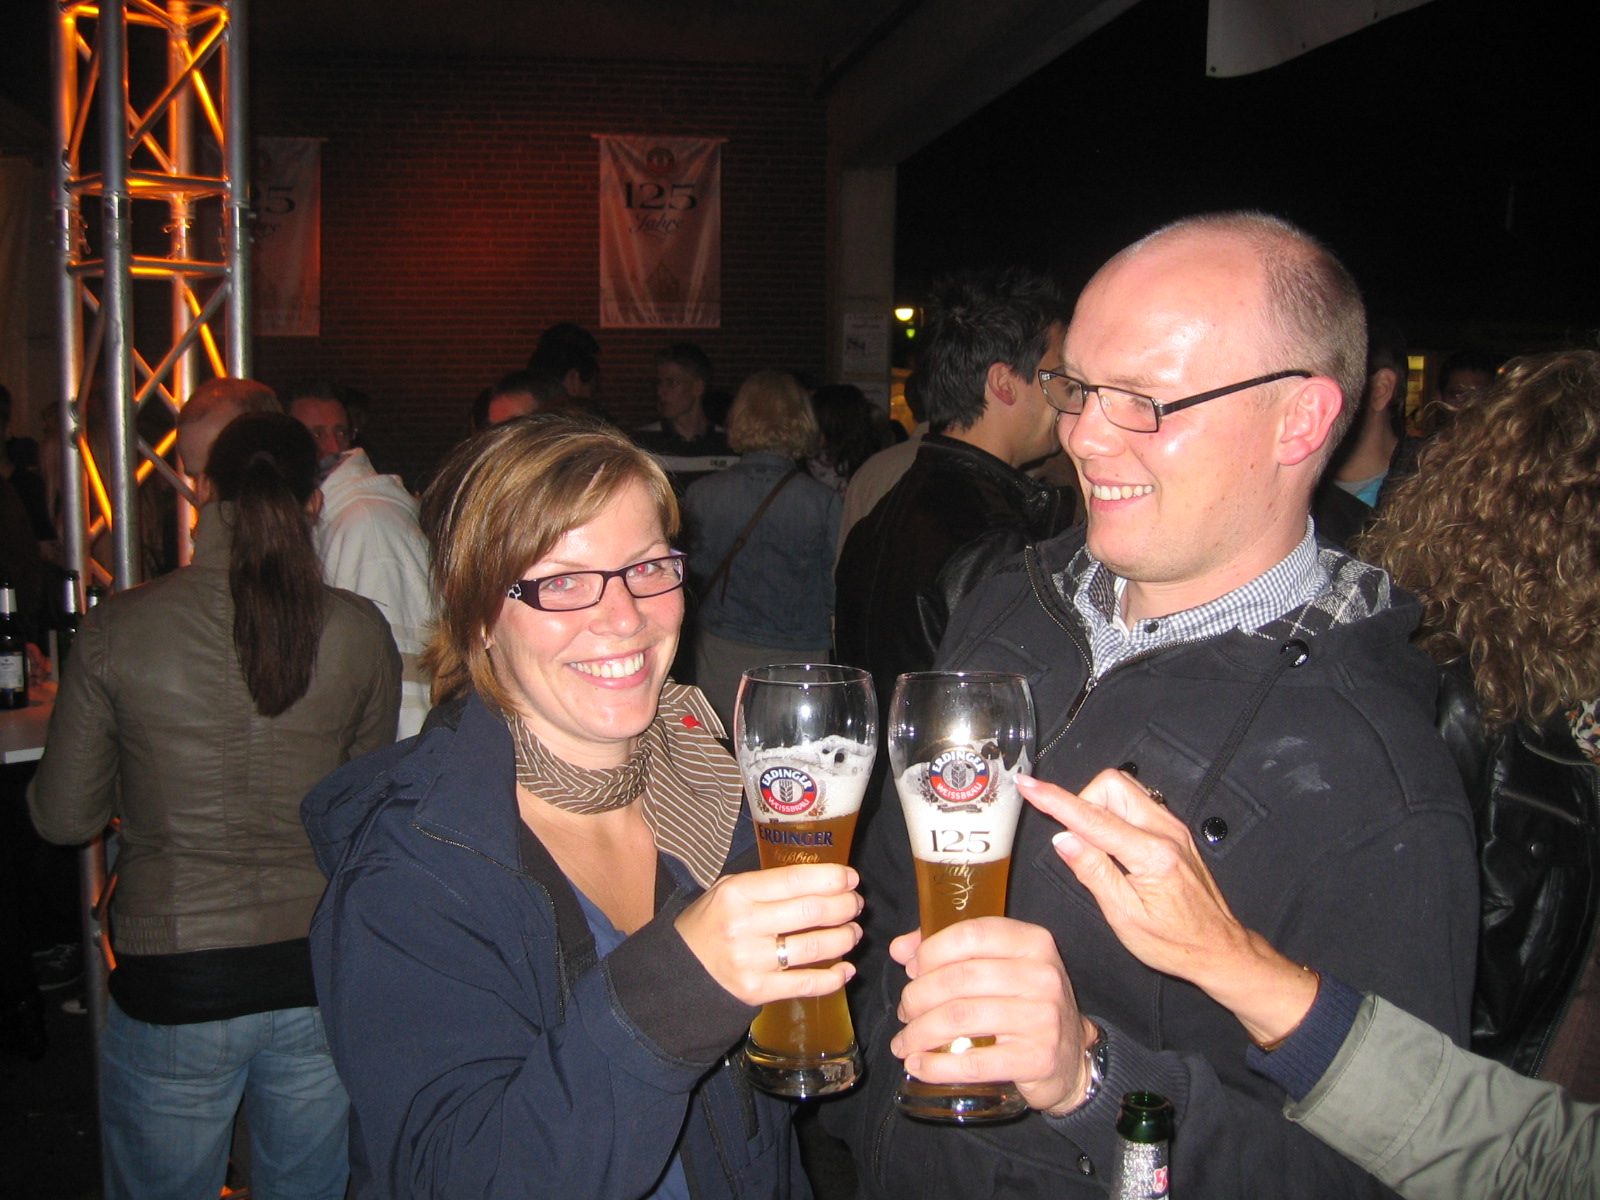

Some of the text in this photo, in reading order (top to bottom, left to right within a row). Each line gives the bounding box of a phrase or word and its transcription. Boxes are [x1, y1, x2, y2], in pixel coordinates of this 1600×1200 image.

[624, 182, 698, 211] 125
[932, 750, 986, 773] ERDINGER
[761, 769, 813, 790] ERDINGER
[759, 824, 834, 847] ERDINGER
[930, 829, 991, 854] 125
